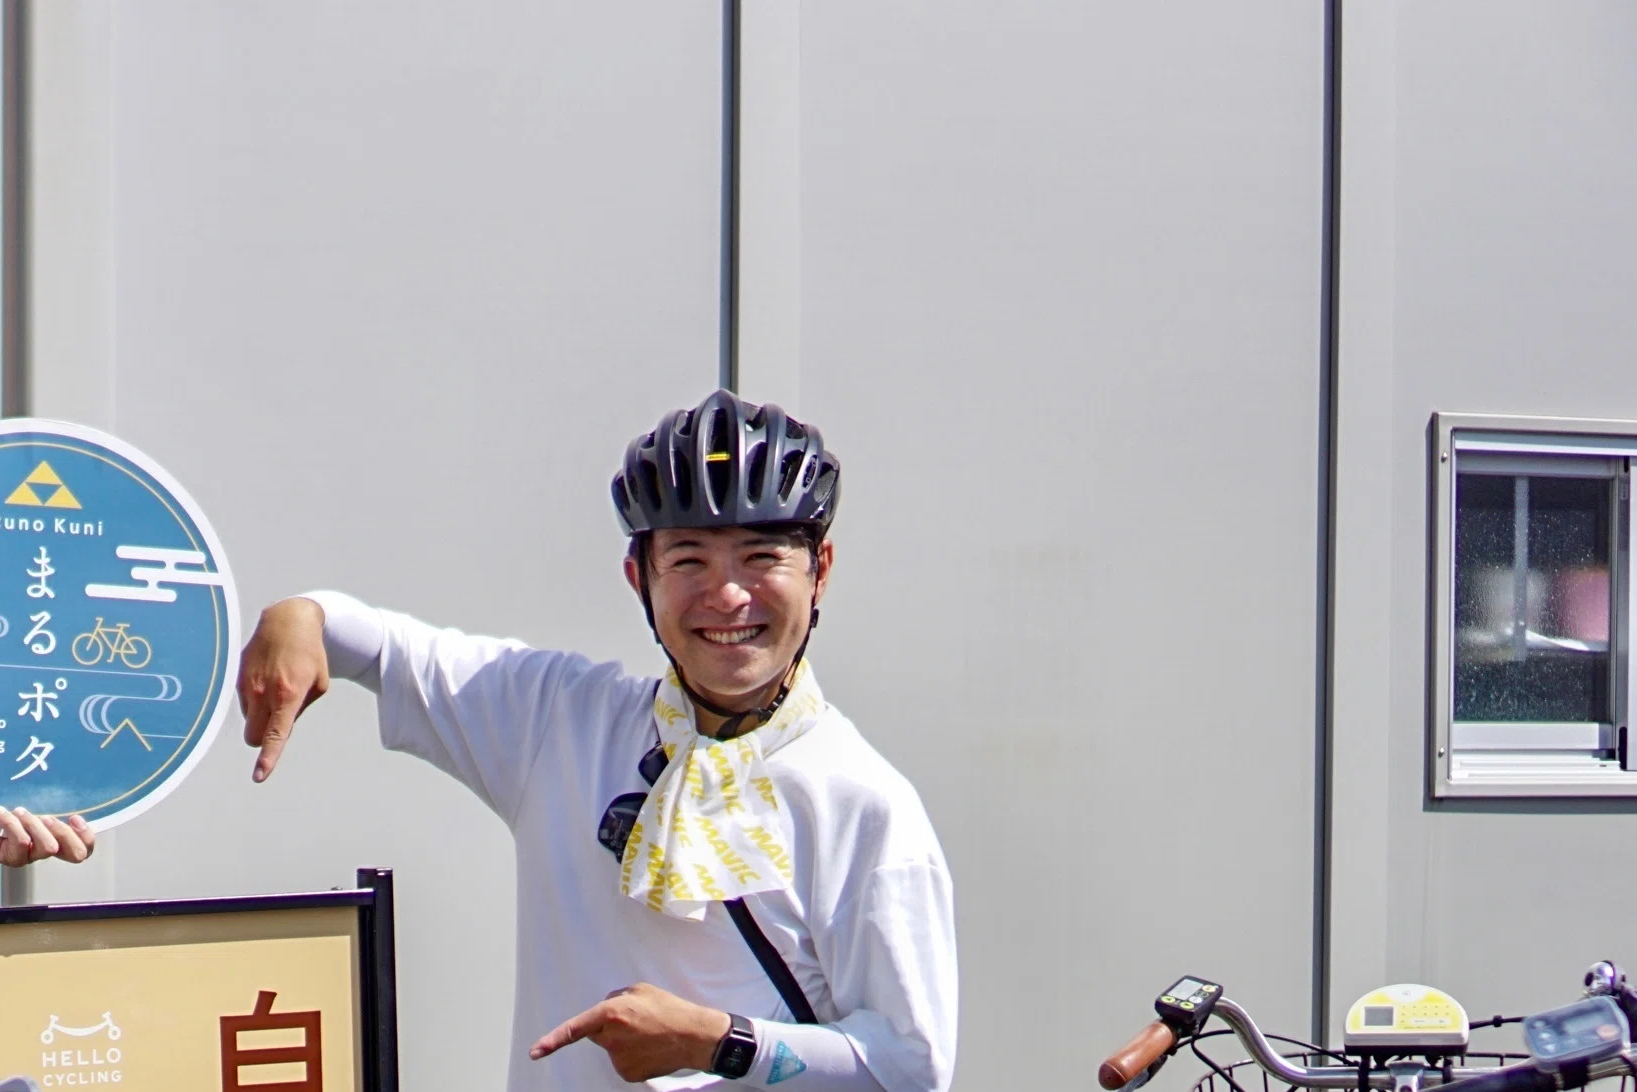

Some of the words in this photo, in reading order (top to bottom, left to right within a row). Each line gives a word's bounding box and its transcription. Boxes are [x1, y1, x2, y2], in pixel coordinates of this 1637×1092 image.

[54, 518, 105, 536] Kuni
[10, 546, 68, 781] まるポタ
[694, 816, 762, 885] MAVIC
[42, 1047, 122, 1067] HELLO
[43, 1069, 123, 1088] CYCLING
